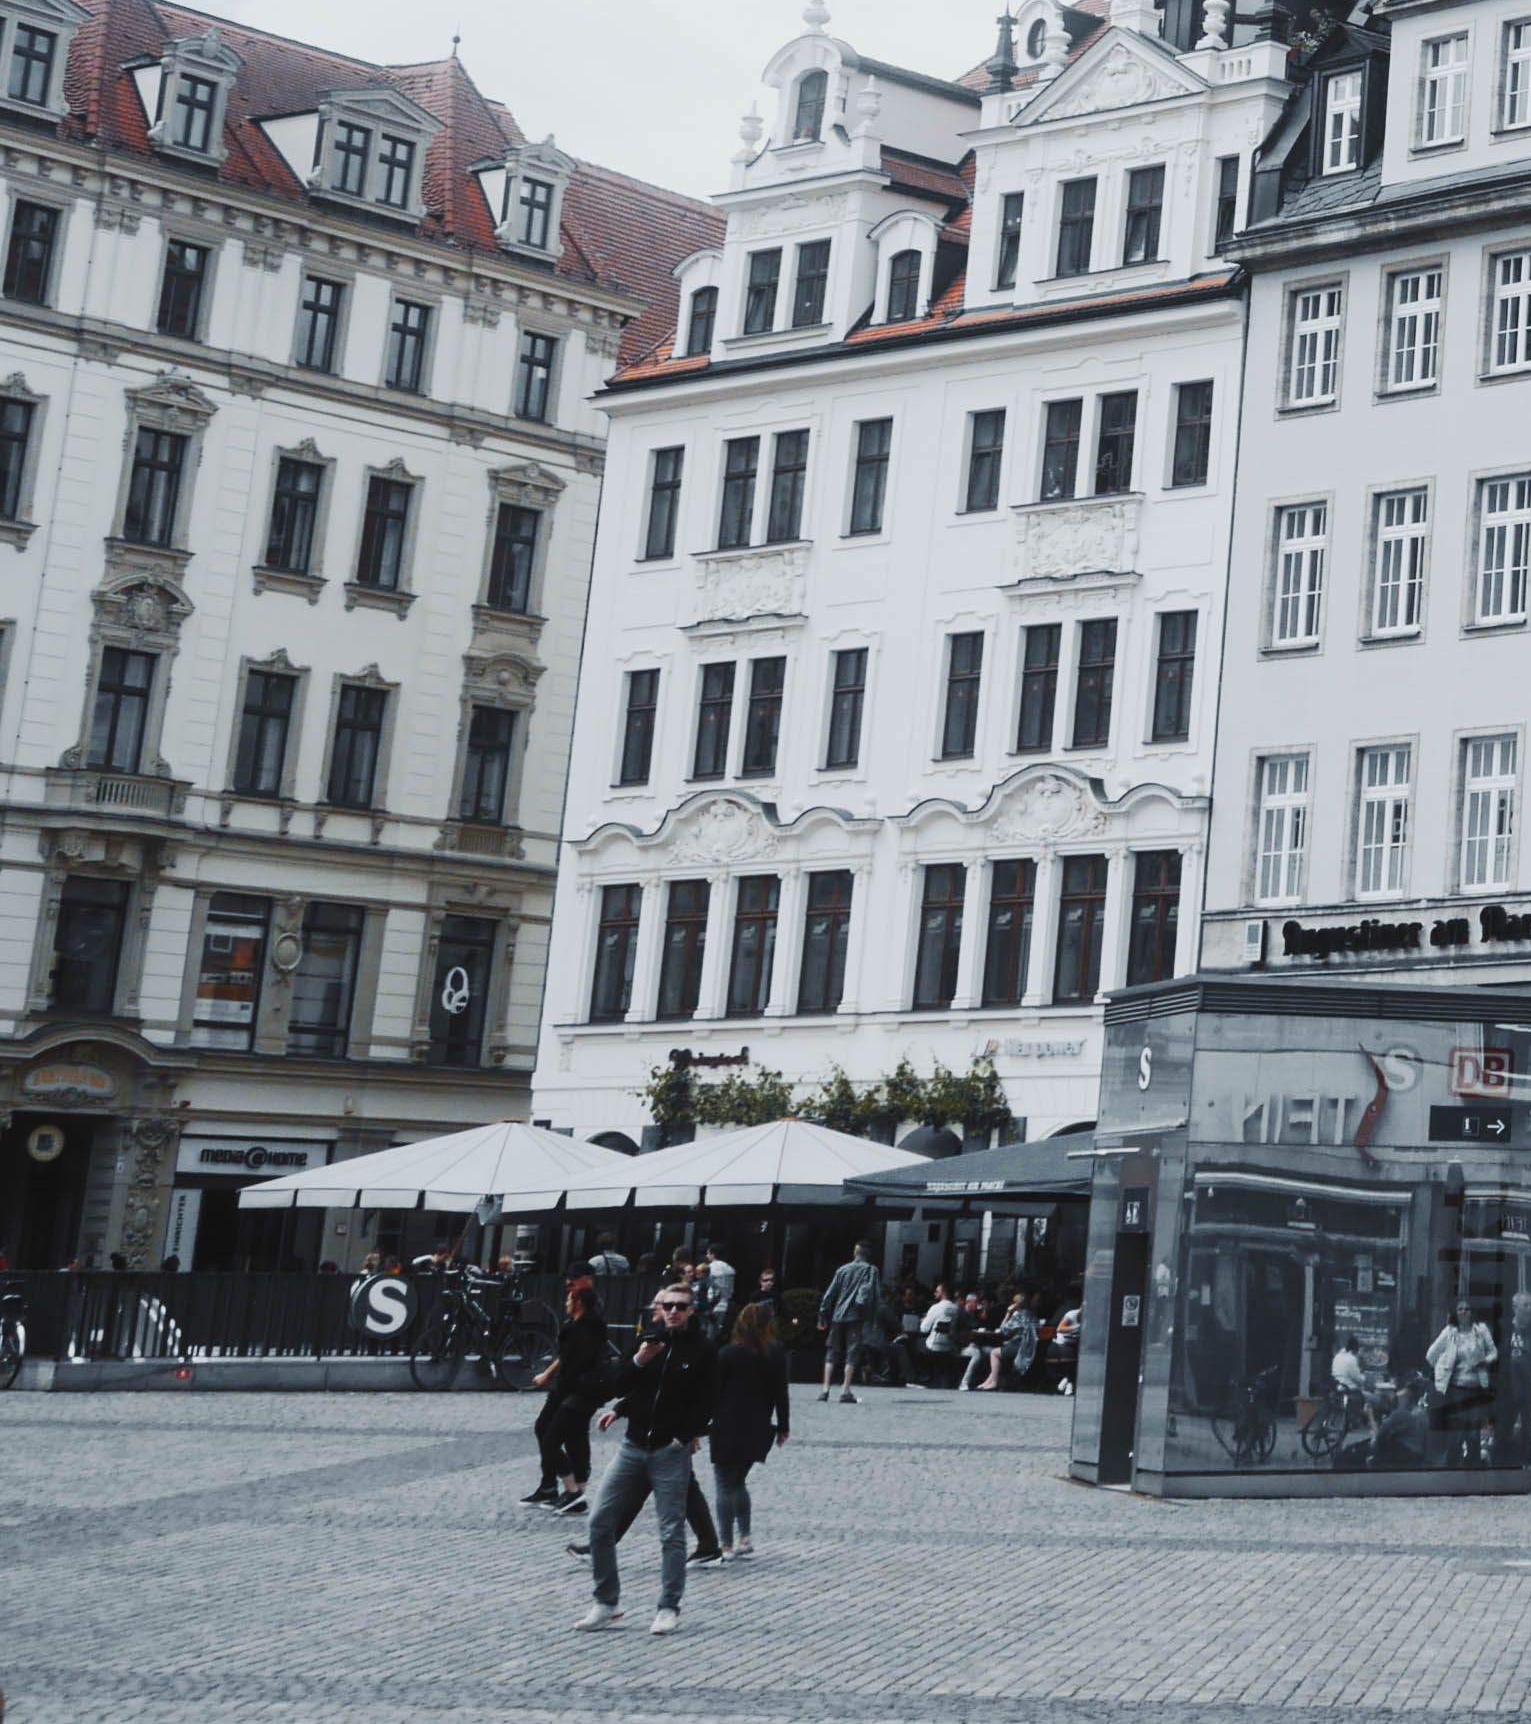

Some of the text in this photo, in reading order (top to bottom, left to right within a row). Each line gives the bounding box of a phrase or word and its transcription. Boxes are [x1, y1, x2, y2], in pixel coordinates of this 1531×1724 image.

[1138, 1046, 1153, 1091] S
[1383, 1047, 1416, 1092] S
[1457, 1055, 1506, 1089] DB
[366, 1278, 408, 1334] S
